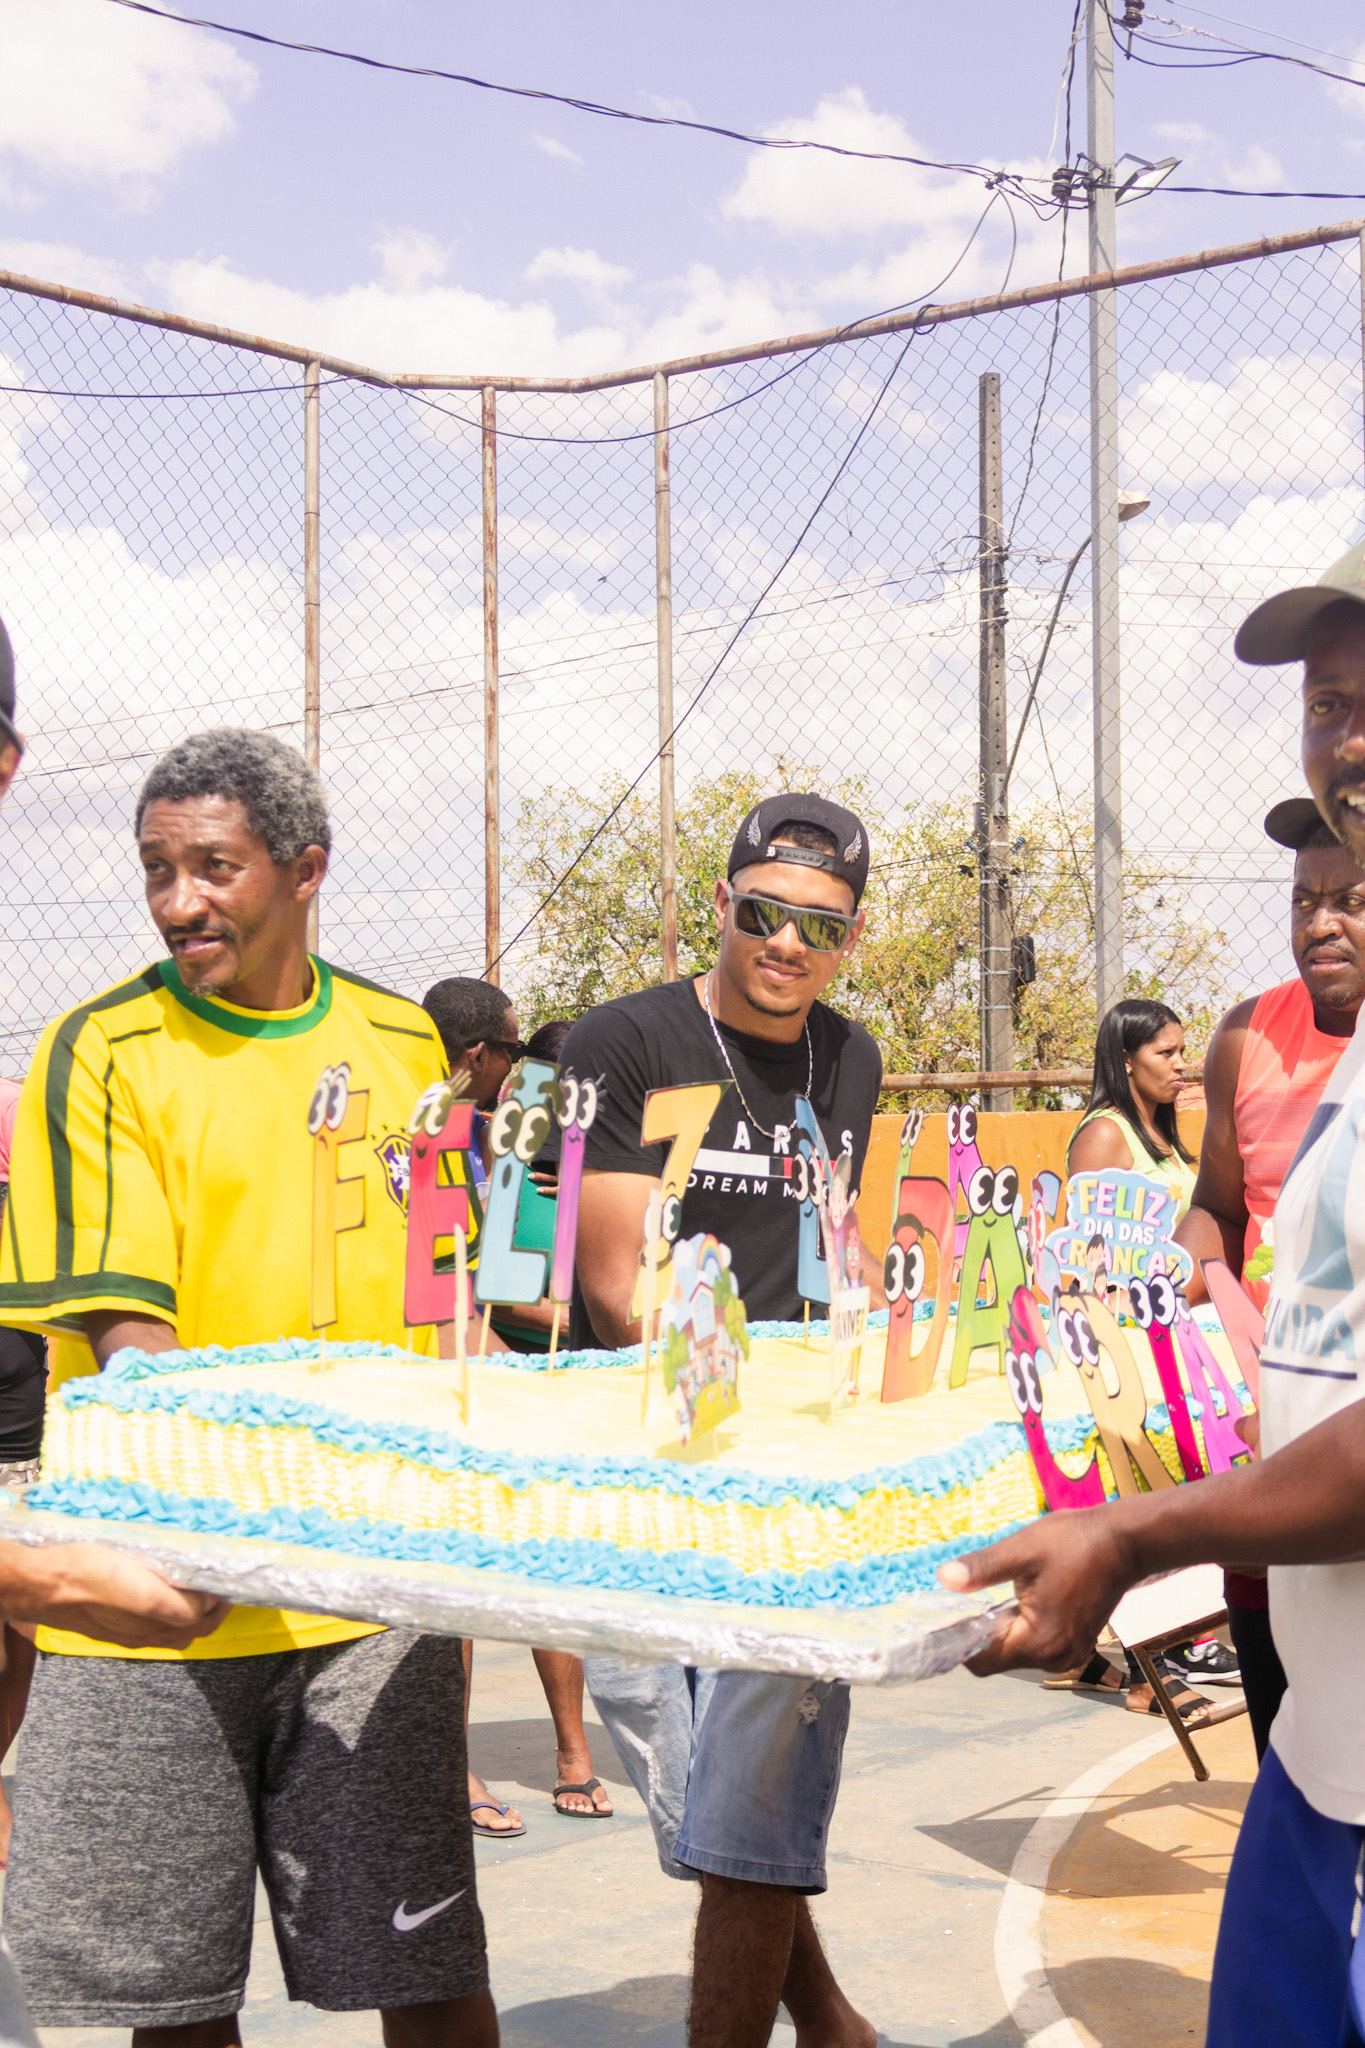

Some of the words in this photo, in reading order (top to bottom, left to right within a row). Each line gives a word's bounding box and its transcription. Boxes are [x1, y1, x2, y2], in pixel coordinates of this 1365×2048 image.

[705, 1120, 854, 1158] ARS
[1078, 1179, 1167, 1227] FELIZ
[1083, 1216, 1114, 1240] DIA
[1118, 1221, 1155, 1246] DAS
